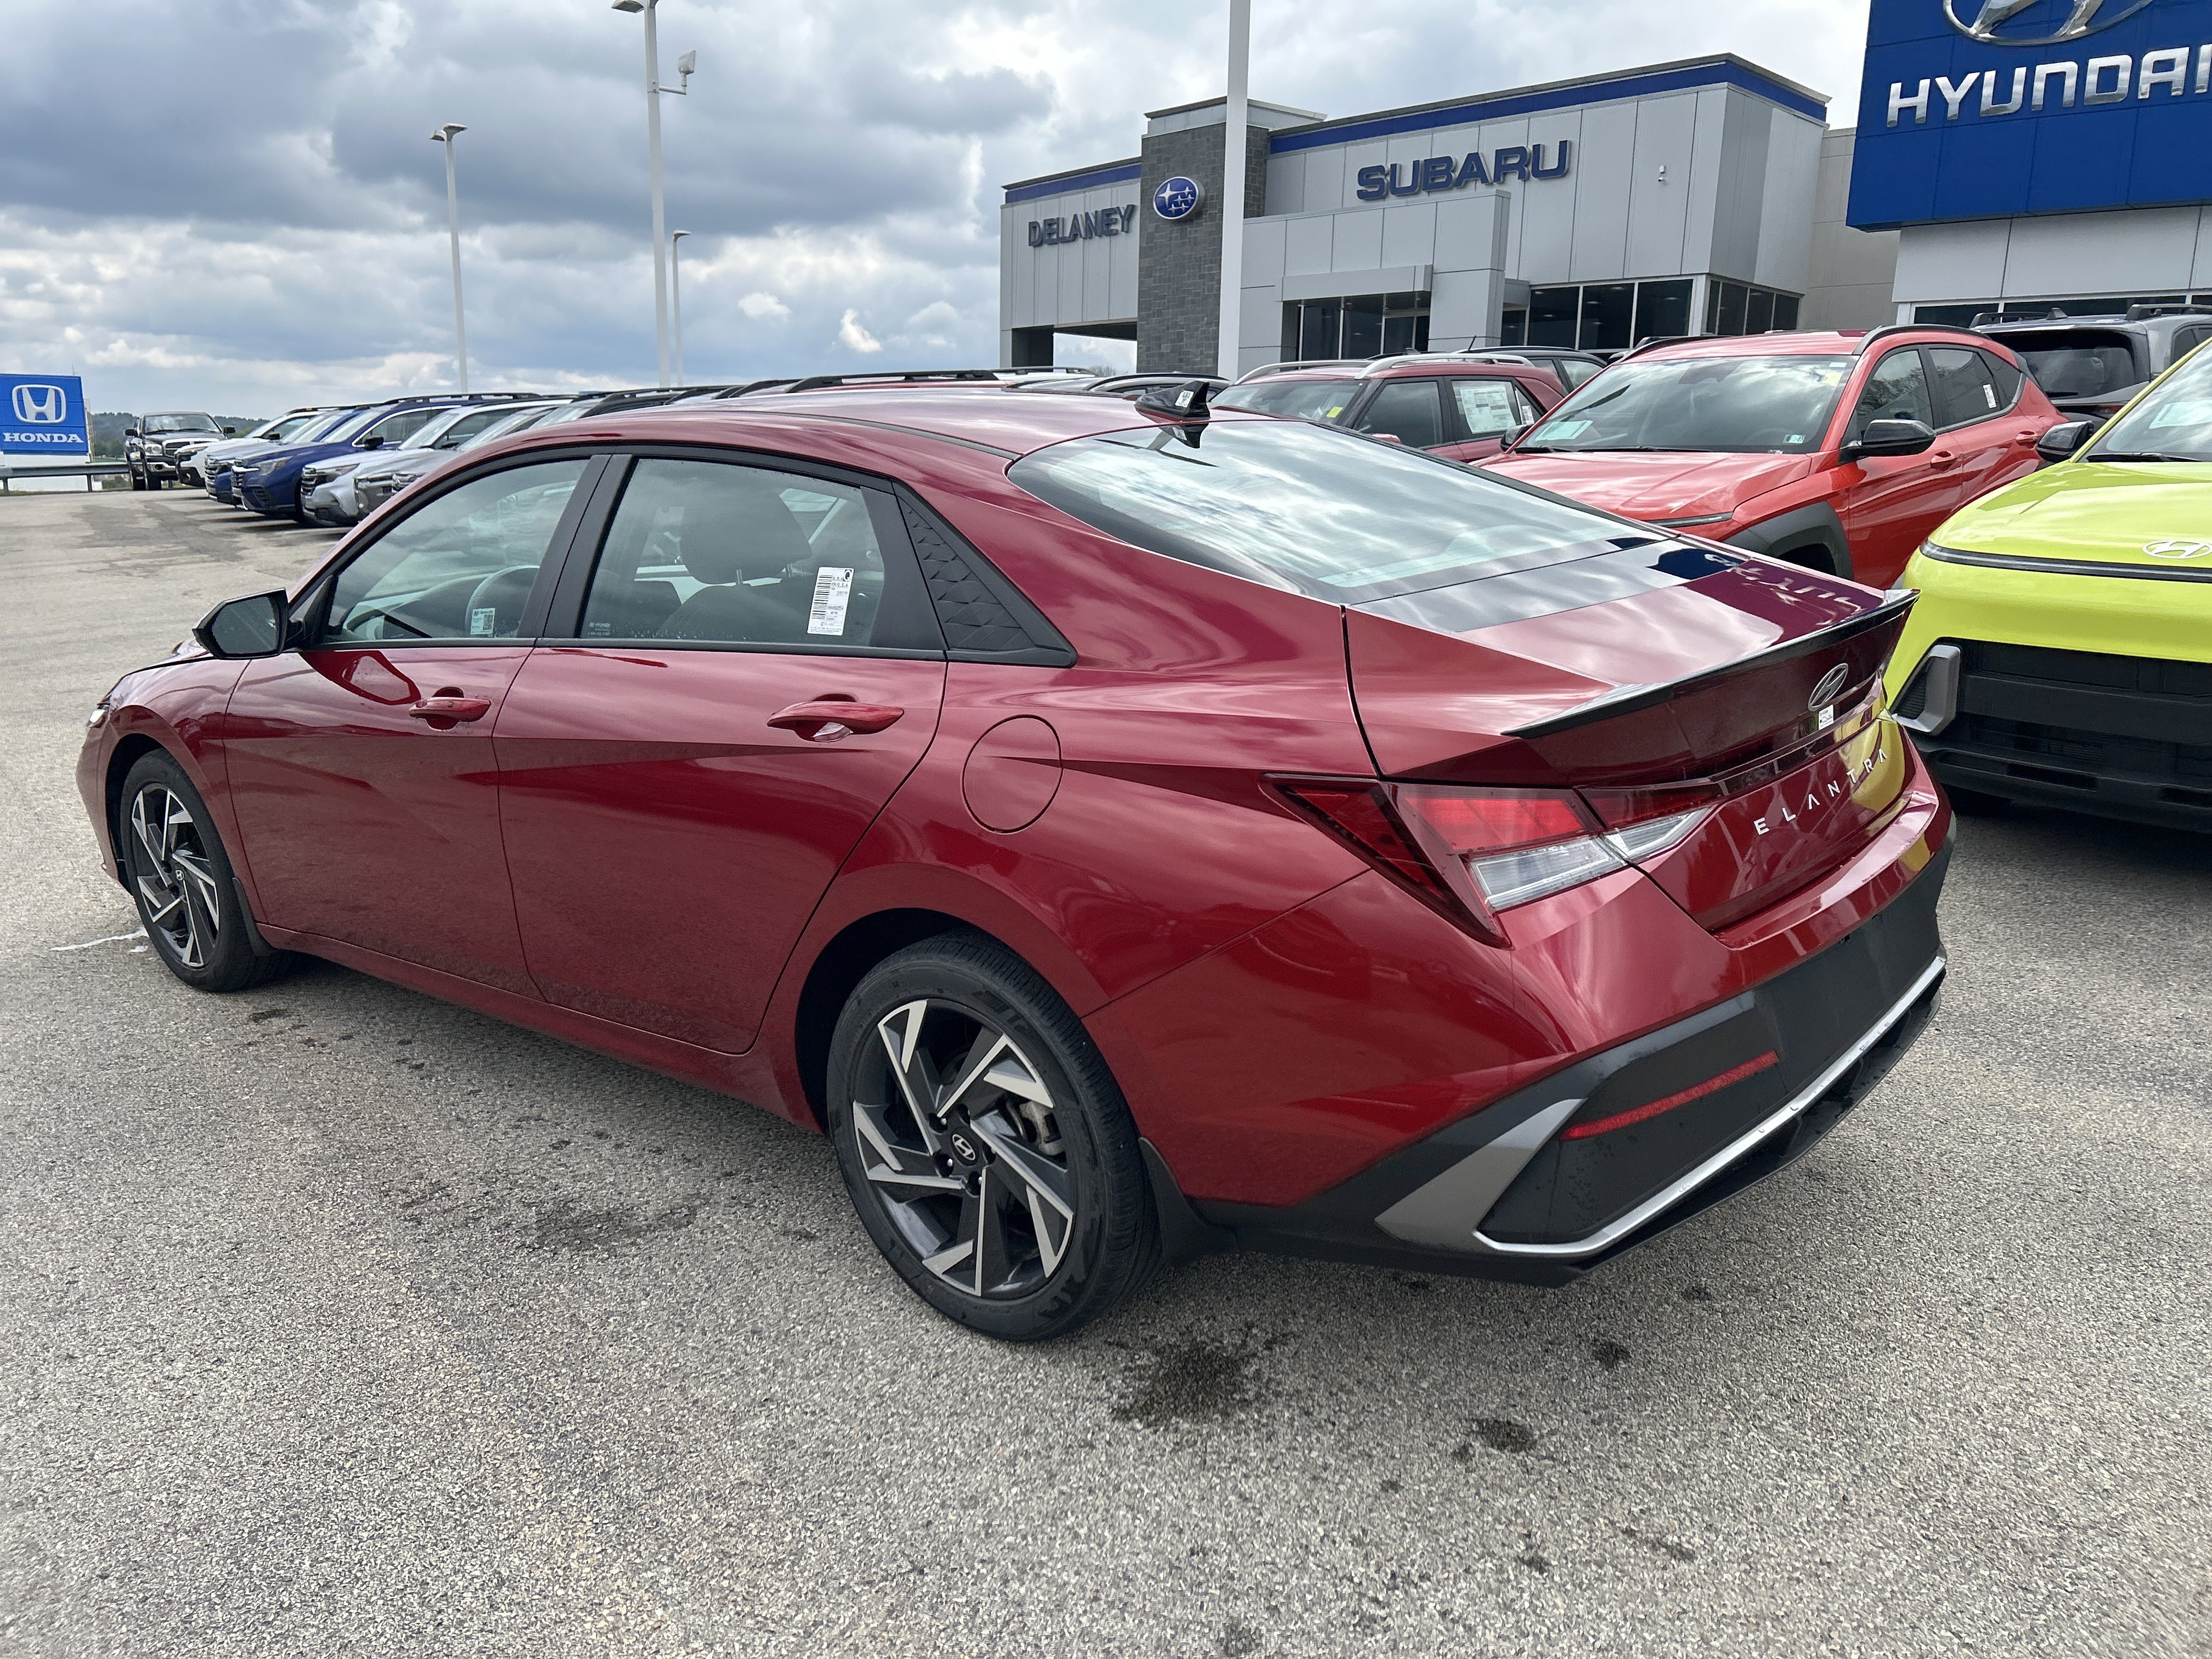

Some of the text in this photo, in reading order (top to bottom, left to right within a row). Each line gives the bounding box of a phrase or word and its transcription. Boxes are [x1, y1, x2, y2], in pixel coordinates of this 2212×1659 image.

[1887, 44, 2212, 127] HYUNDAI
[1356, 140, 1572, 201] SUBARU
[1028, 204, 1136, 247] DELANEY
[3, 432, 84, 443] HONDA
[1753, 748, 1887, 835] ELANTRA
